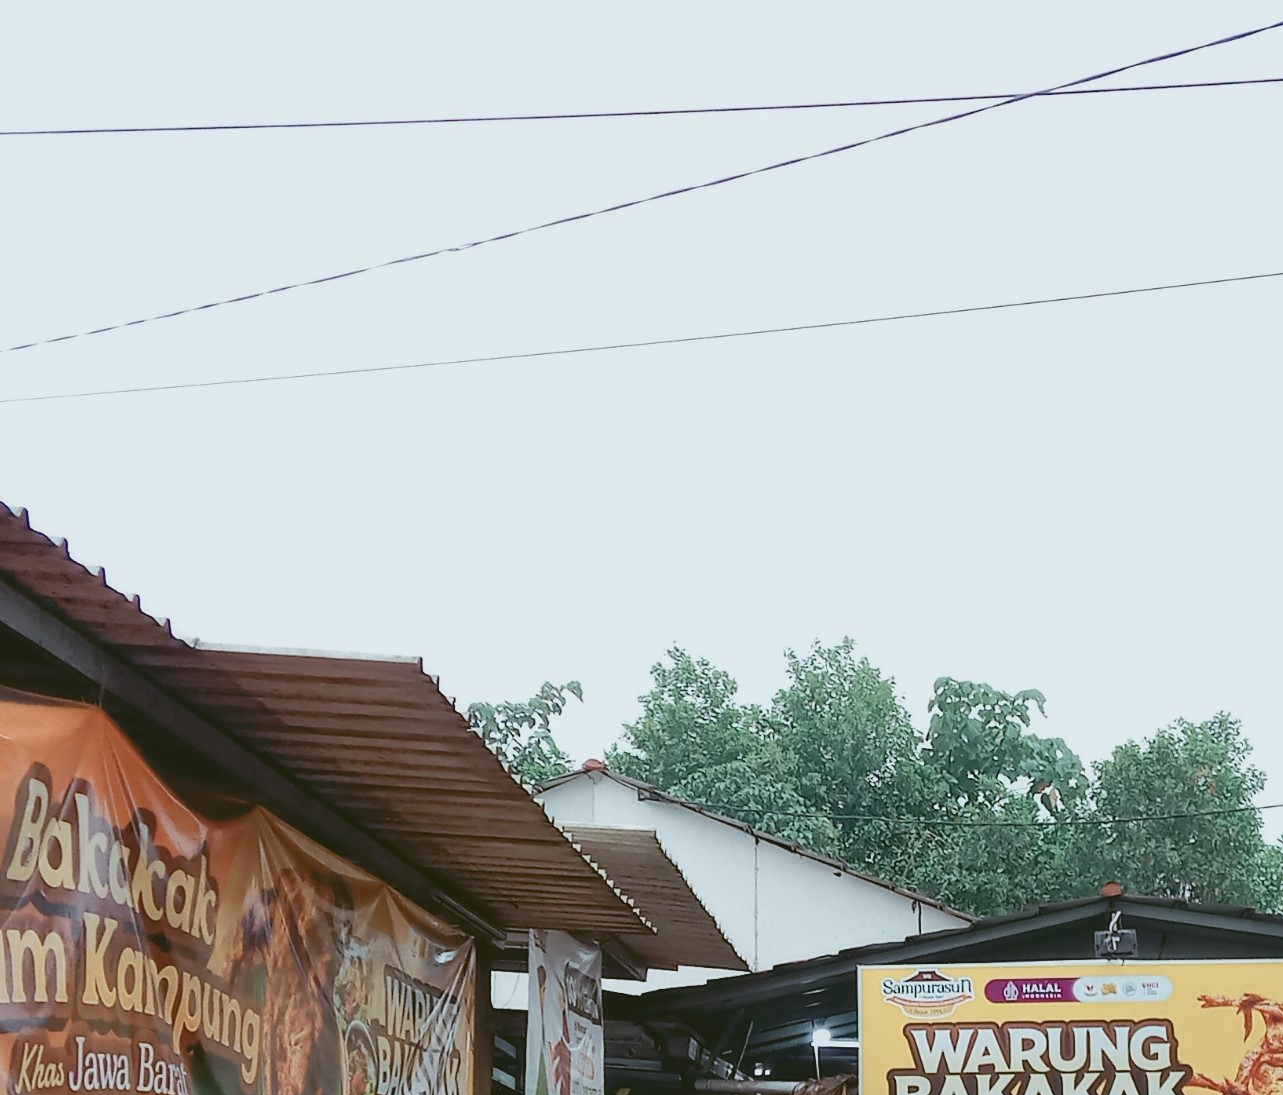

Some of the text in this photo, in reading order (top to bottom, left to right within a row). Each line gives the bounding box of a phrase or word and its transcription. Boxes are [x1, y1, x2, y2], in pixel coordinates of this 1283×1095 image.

[6, 778, 218, 945] Bakakak
[0, 928, 67, 1003] m
[882, 979, 971, 1001] Sampurasun
[1022, 982, 1062, 993] HALAL
[14, 1042, 65, 1095] Khas
[69, 1036, 130, 1092] Jawa
[910, 1025, 1172, 1073] WARUNG
